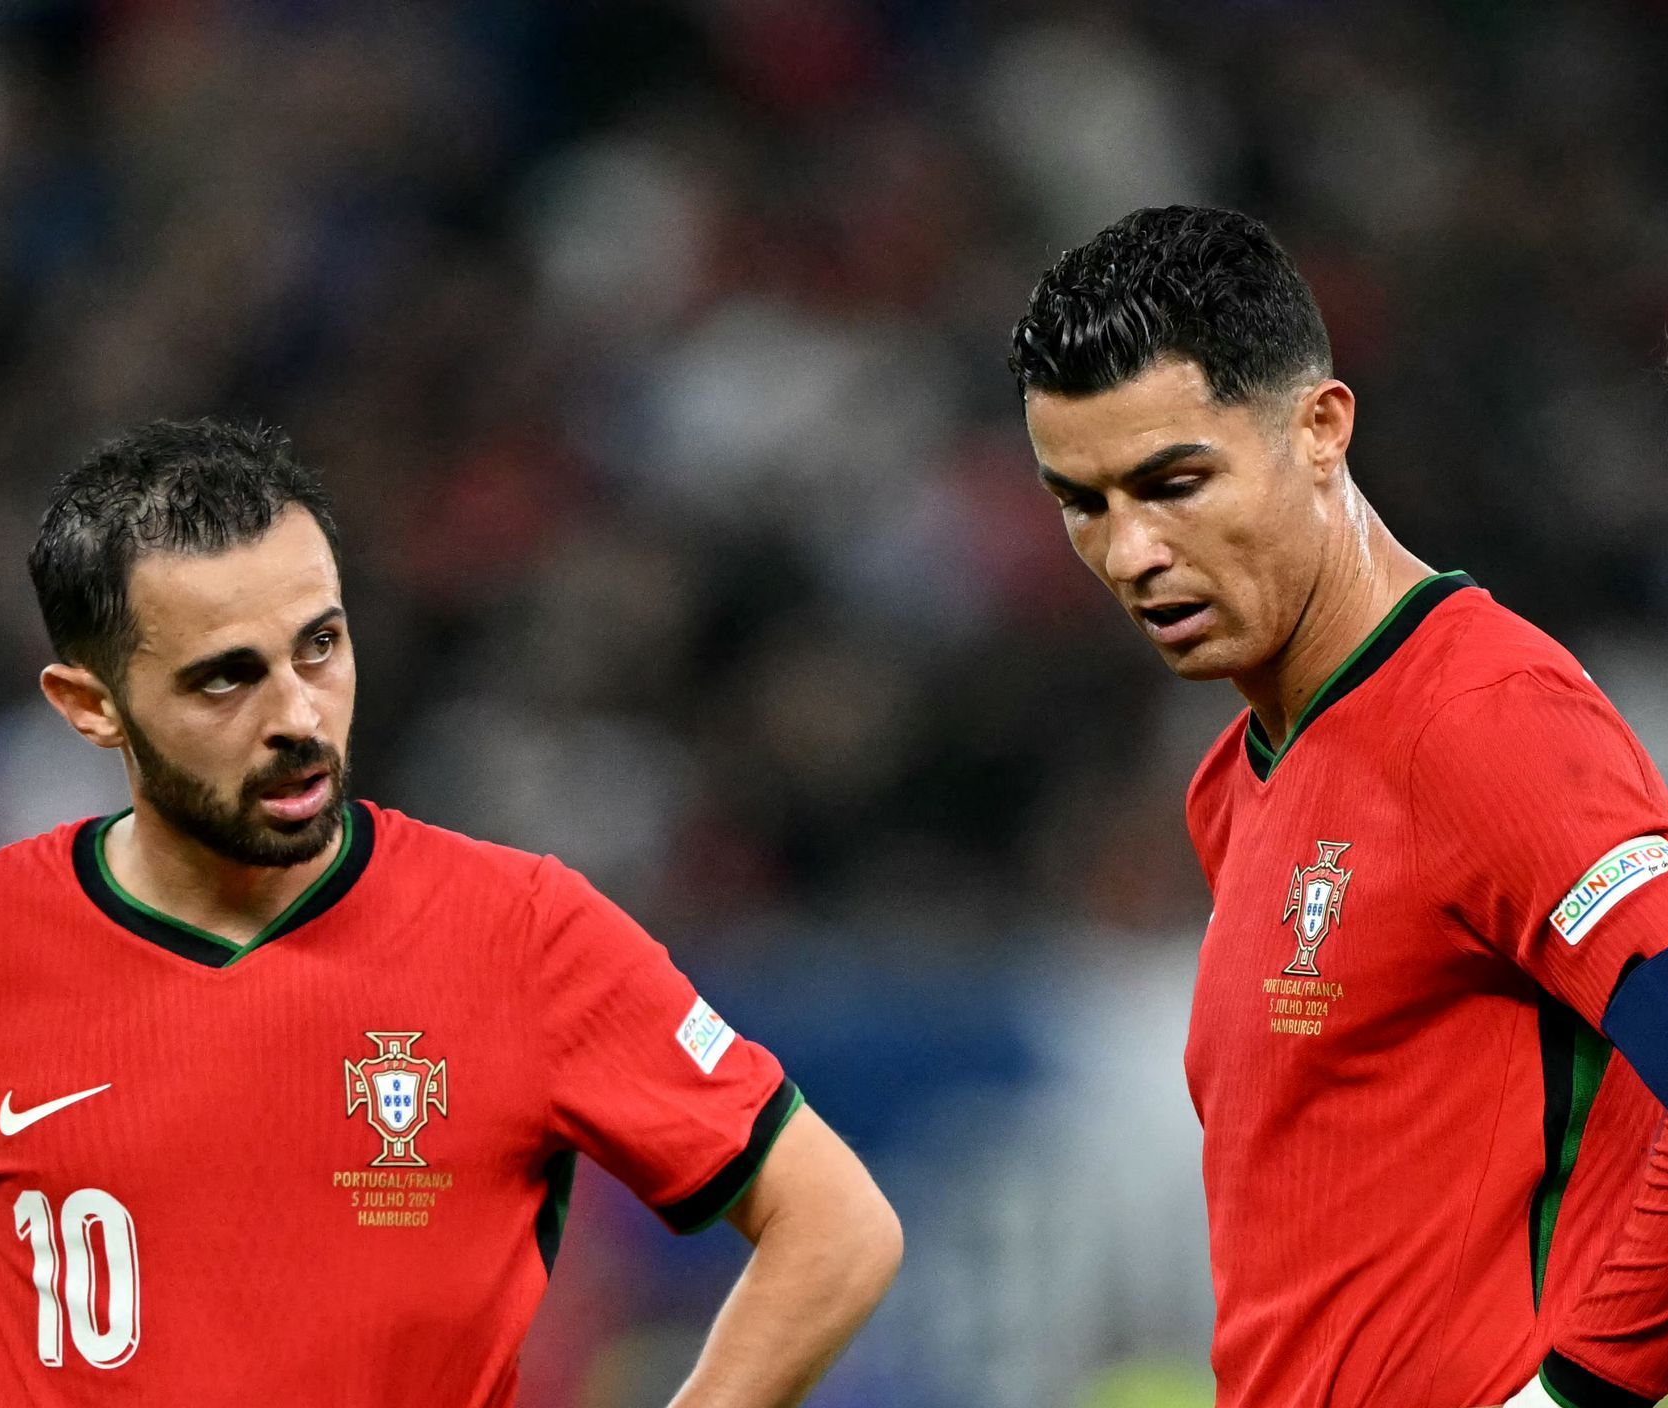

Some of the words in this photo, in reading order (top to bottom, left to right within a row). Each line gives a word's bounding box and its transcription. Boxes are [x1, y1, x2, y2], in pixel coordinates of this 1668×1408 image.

[1262, 978, 1344, 1001] PORTUGAL/FRANÇA
[1305, 1000, 1329, 1017] 2024
[1271, 1018, 1321, 1035] HAMBURGO
[333, 1171, 453, 1191] PORTUGAL/FRANÇA
[363, 1192, 405, 1208] JULHO
[358, 1211, 429, 1227] HAMBURGO
[13, 1187, 141, 1369] 10
